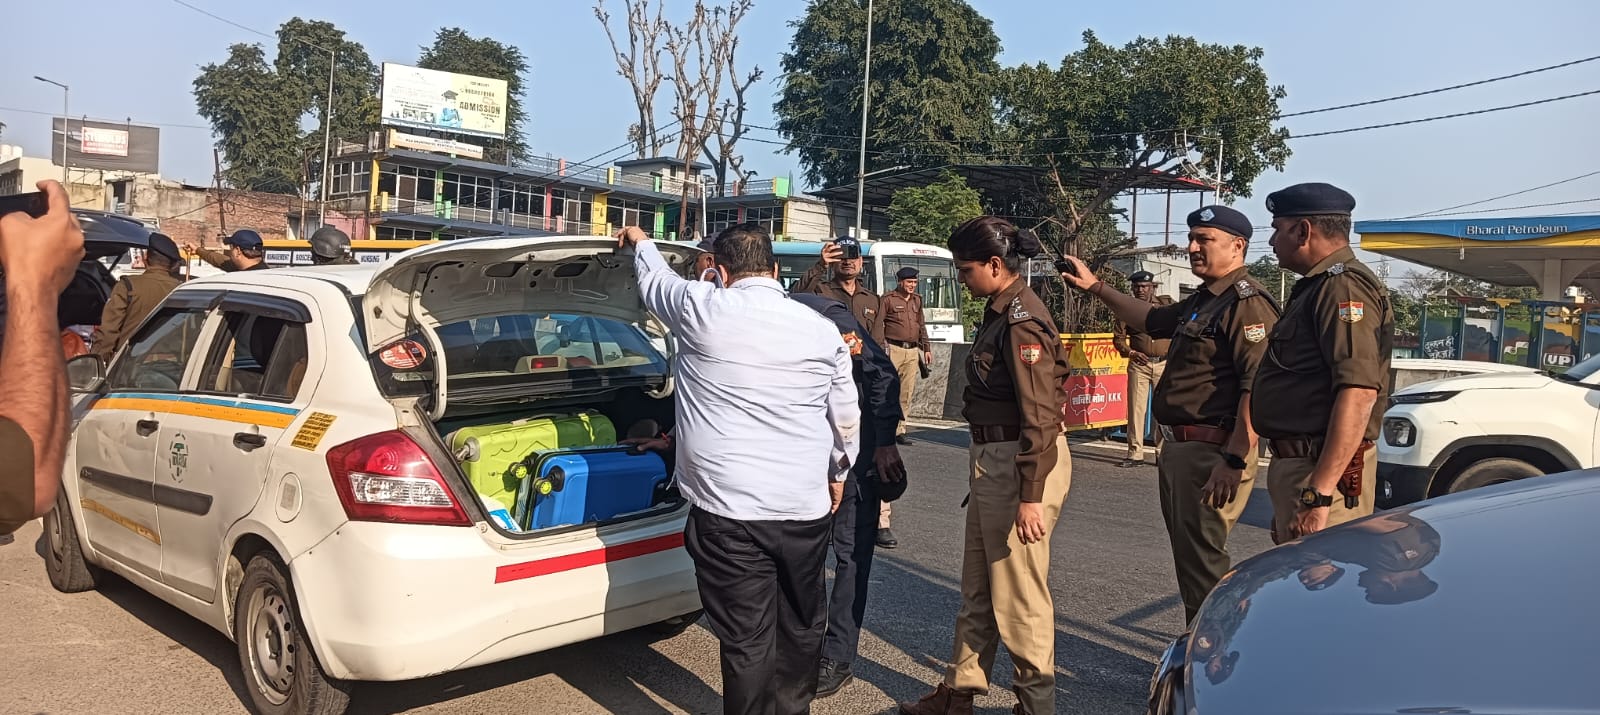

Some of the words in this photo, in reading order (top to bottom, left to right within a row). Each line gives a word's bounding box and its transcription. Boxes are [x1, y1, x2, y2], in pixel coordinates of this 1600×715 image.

[459, 101, 501, 115] ADMISSION
[1466, 225, 1504, 235] Bharat
[1507, 224, 1568, 234] Petroleum
[360, 255, 380, 263] NURSING
[1547, 354, 1571, 365] UP
